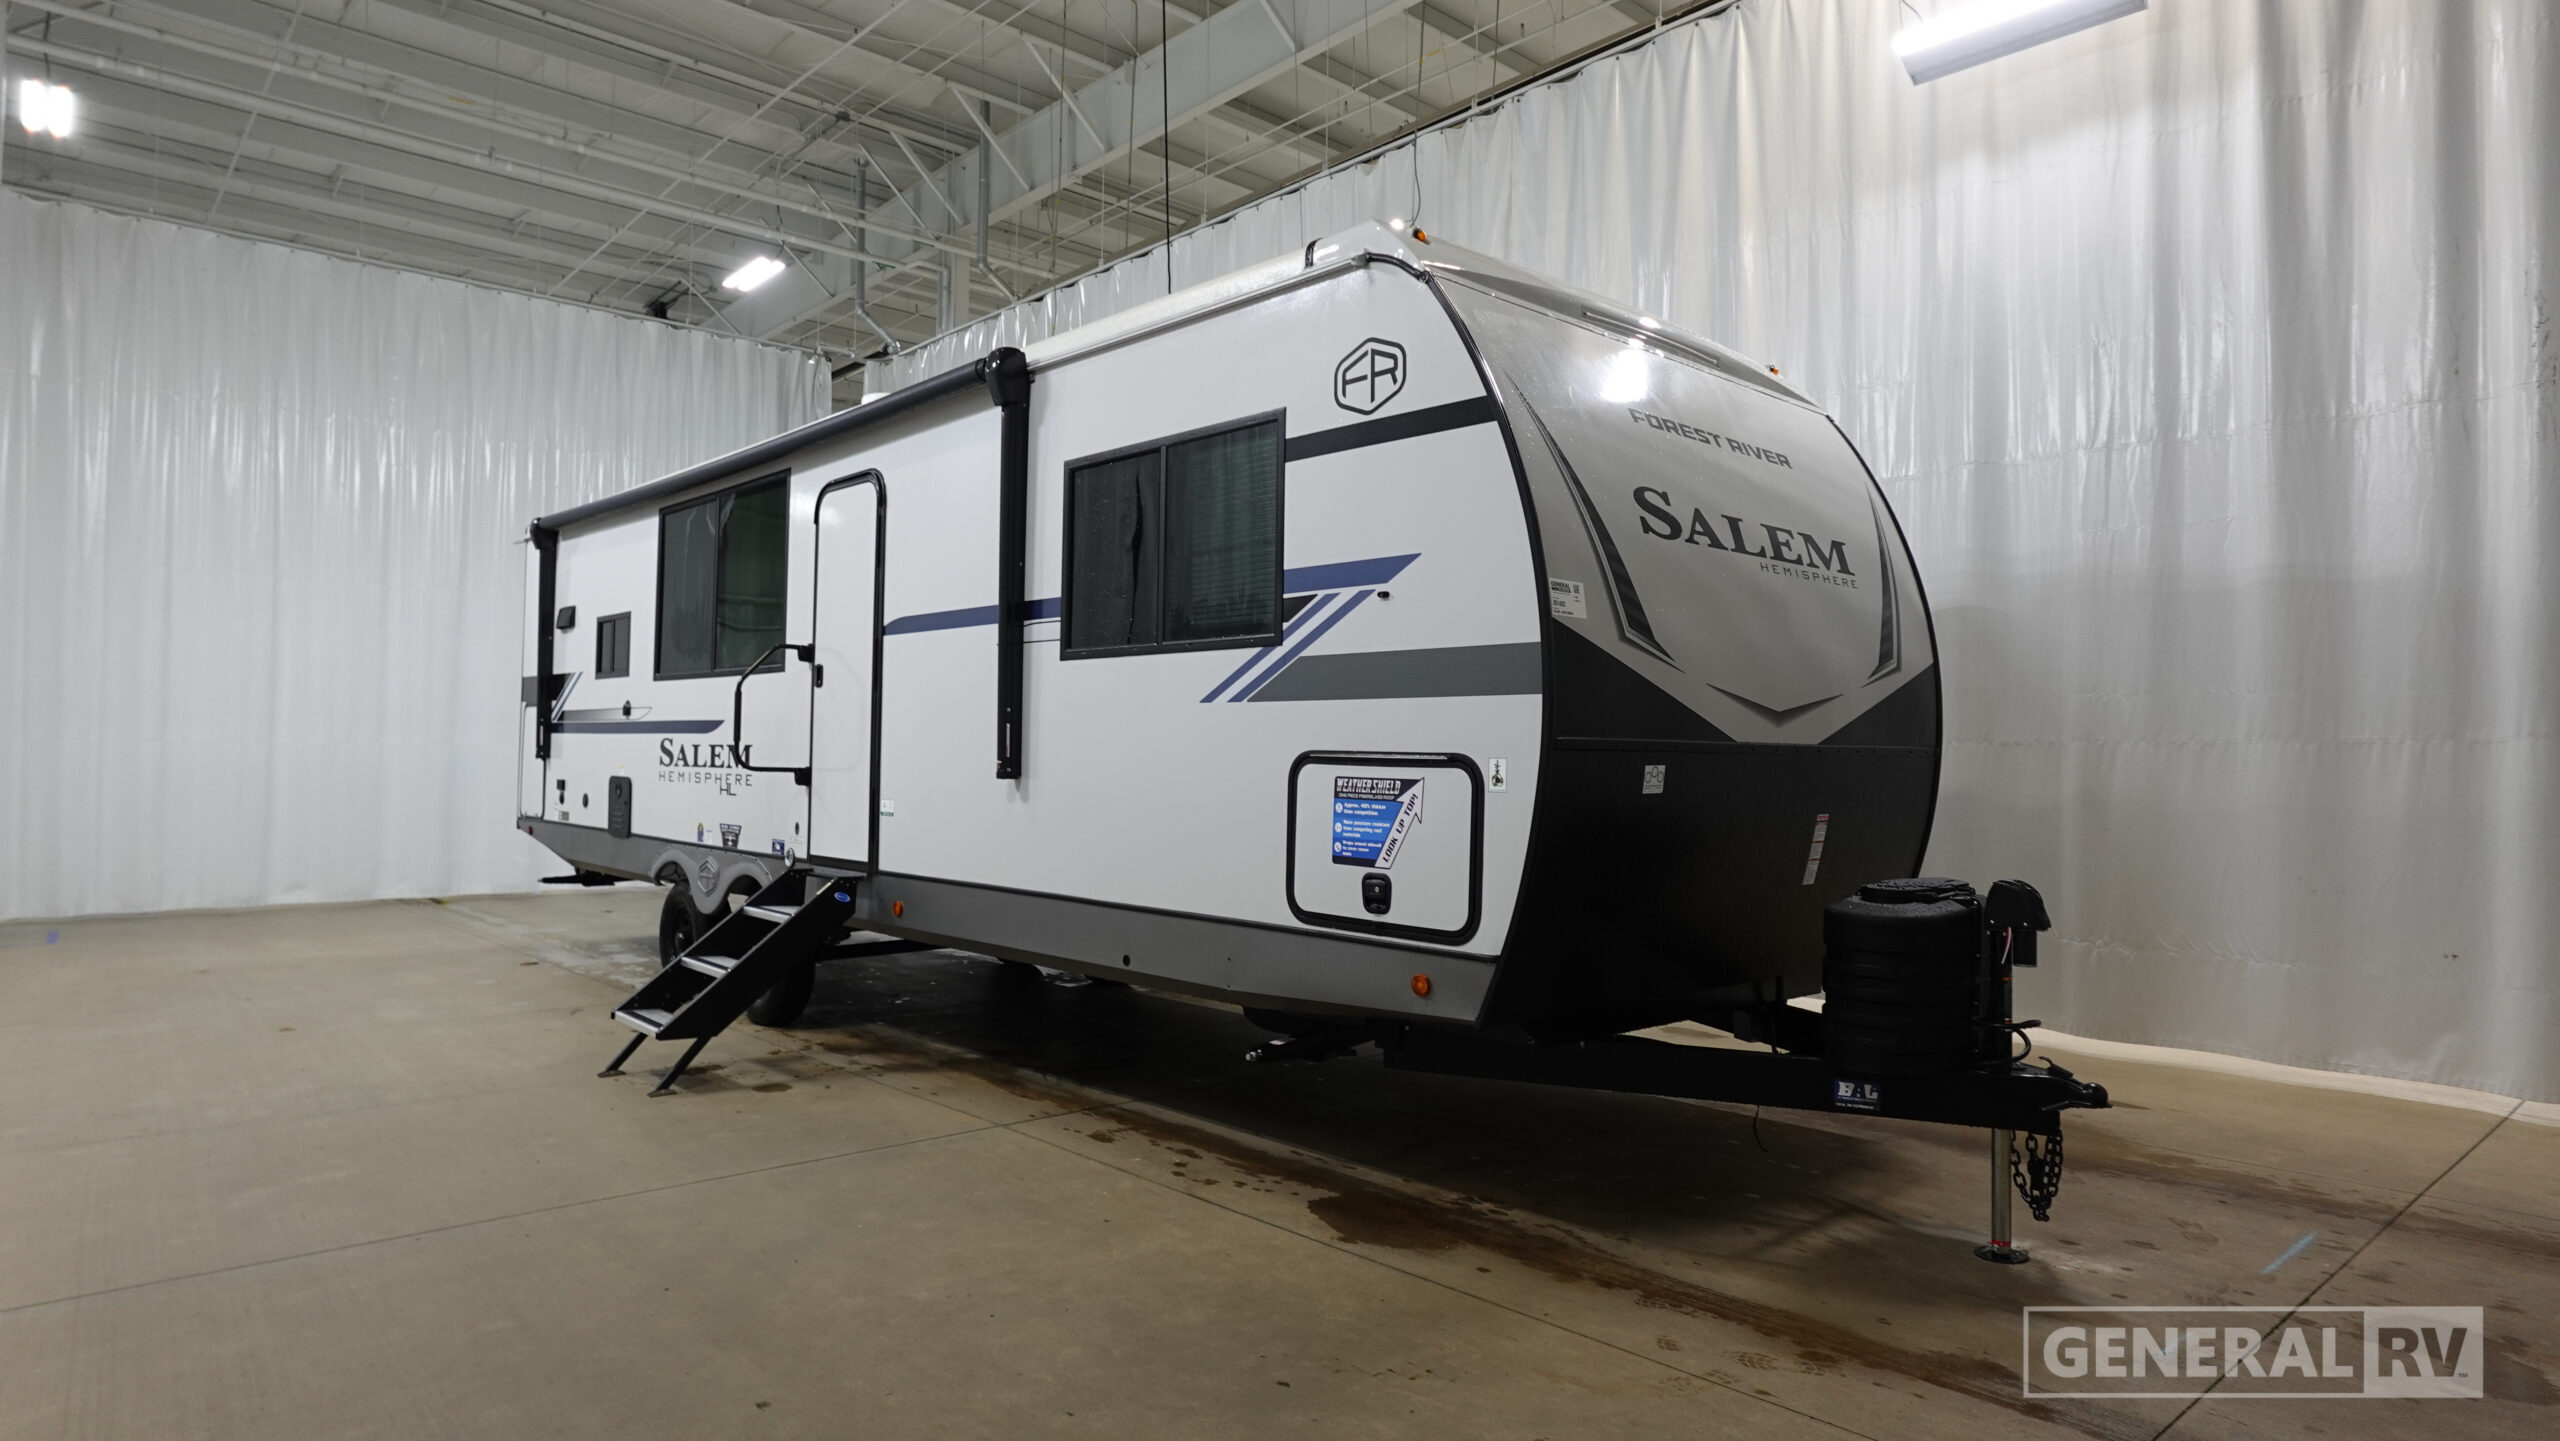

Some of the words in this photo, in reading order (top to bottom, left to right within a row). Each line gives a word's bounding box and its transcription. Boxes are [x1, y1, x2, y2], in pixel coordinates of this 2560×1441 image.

[1628, 407, 1722, 449] FOREST
[1724, 436, 1793, 470] RIVER
[1632, 486, 1856, 577] SALEM
[1759, 562, 1858, 589] HEMISPHERE
[659, 737, 754, 769] SALEM
[658, 770, 753, 787] HEMISPHERE
[1382, 837, 1398, 863] LOOK
[1395, 818, 1405, 834] UP
[1404, 793, 1419, 817] TOP!
